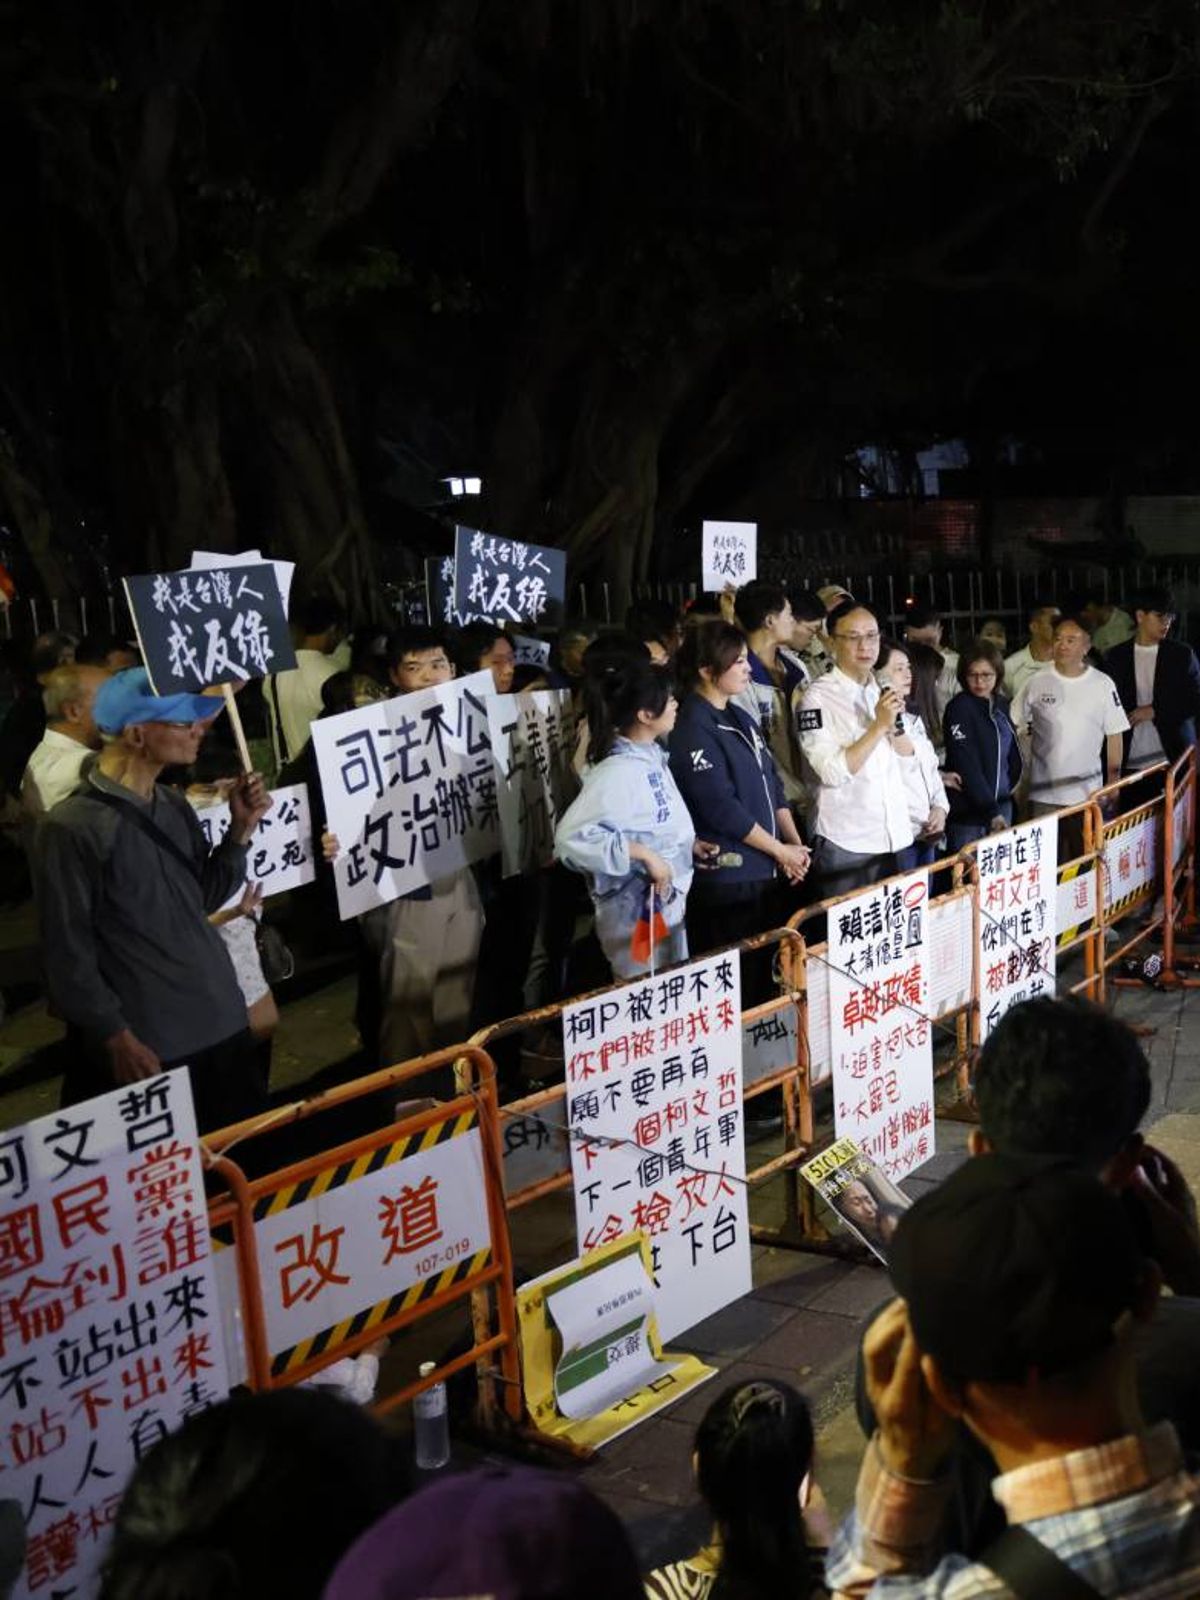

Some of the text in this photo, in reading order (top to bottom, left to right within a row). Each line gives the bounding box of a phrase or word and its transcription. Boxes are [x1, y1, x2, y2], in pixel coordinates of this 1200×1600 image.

[152, 571, 264, 615] 我是台灣人
[470, 530, 551, 573] 我是台灣人
[335, 688, 493, 798] 司法不公
[247, 838, 307, 878] 已死
[347, 759, 500, 887] 政治辦案
[980, 827, 1043, 877] 我們在等
[981, 898, 1047, 952] 你們在等
[985, 863, 1041, 912] 柯文哲
[566, 958, 735, 1045] 柯P被押不來
[569, 1046, 710, 1125] 願不要再有
[575, 1071, 736, 1171] 下一個柯文哲
[580, 1110, 739, 1213] 下一個青年軍
[0, 1140, 193, 1283] 國民黨
[275, 1175, 443, 1309] 改道
[414, 1237, 470, 1277] 107-019
[0, 1275, 208, 1409] 不站出來
[0, 1332, 214, 1472] 站不出來
